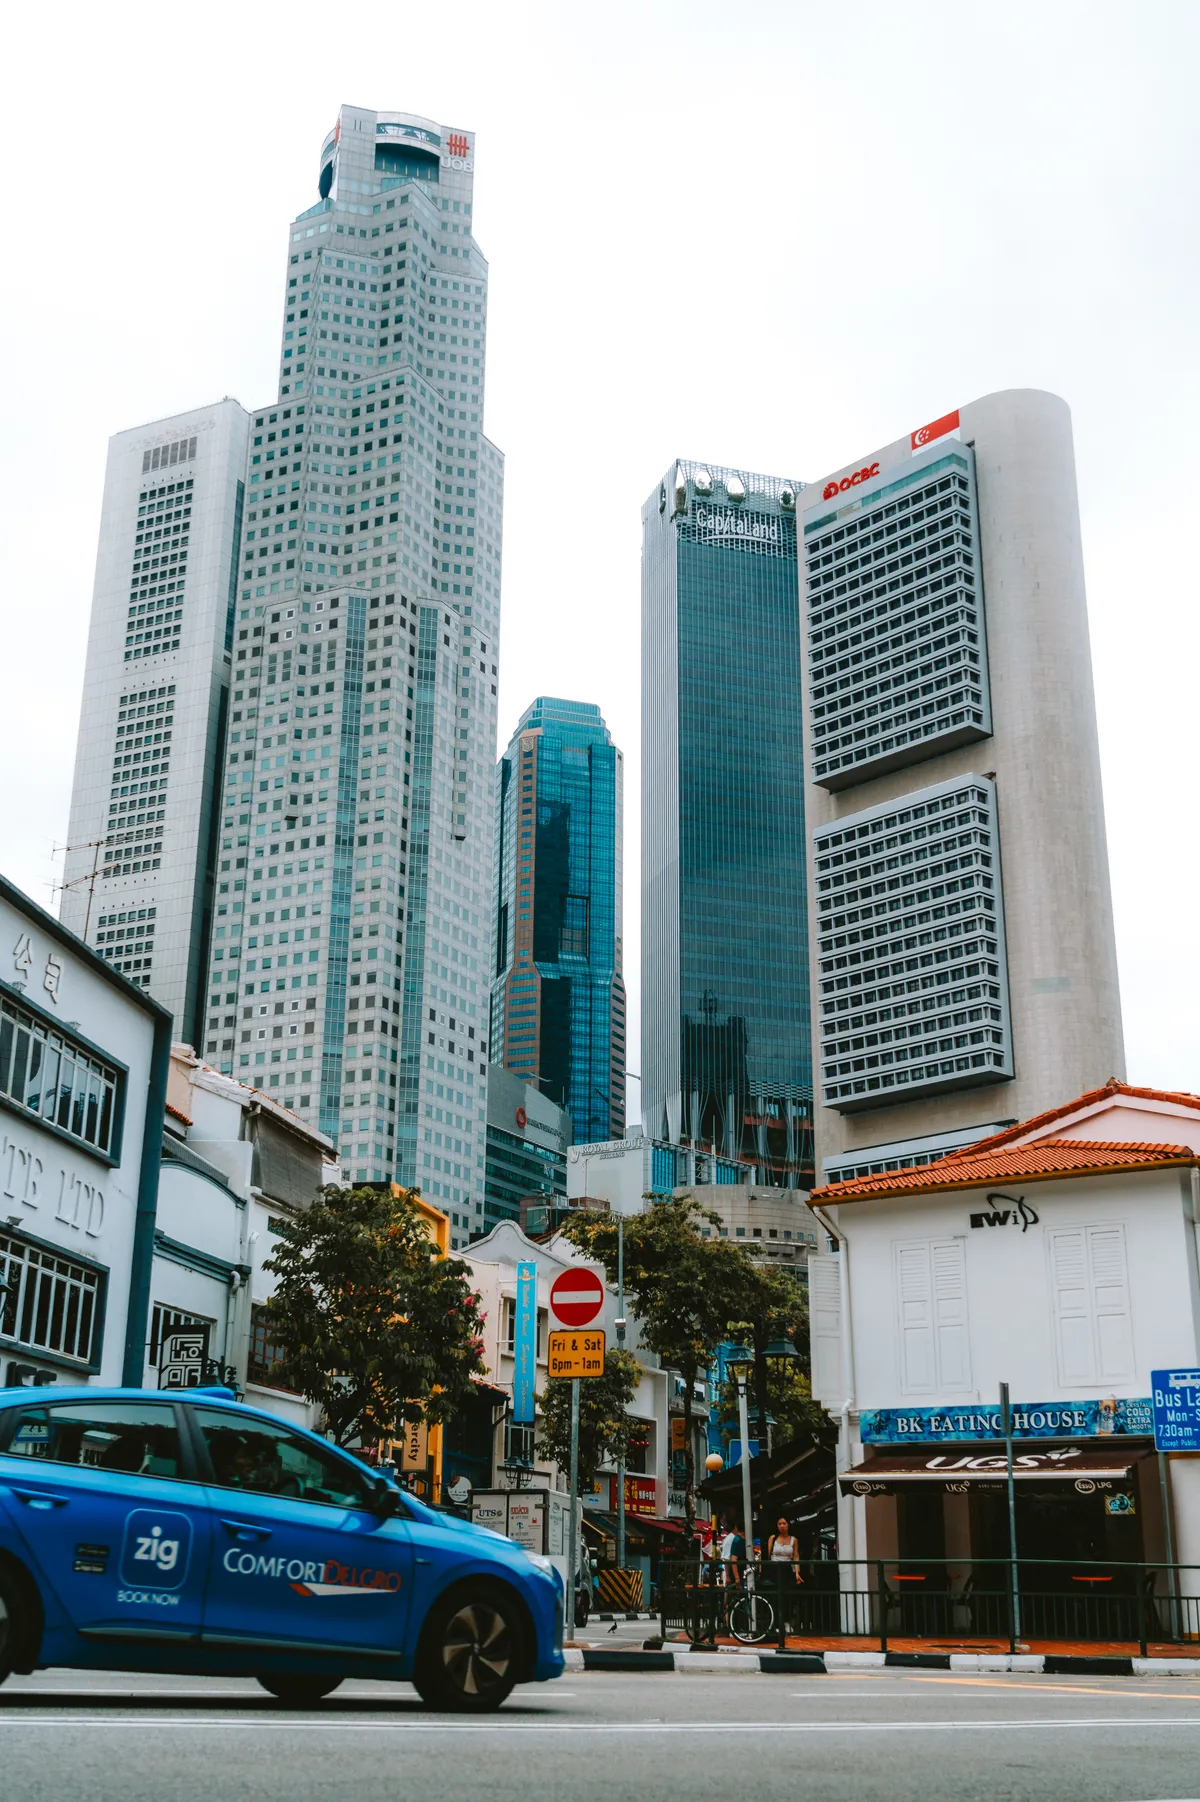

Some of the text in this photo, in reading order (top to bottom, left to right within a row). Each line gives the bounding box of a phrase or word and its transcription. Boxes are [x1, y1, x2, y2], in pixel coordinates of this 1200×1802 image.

[440, 156, 474, 173] UOB
[839, 462, 880, 492] OCBC
[696, 508, 778, 540] CapitaLand
[581, 1137, 643, 1156] ROYAL GROUP
[55, 1169, 104, 1239] LTD
[552, 1338, 602, 1351] Fri & Sat
[1155, 1389, 1182, 1408] Bus
[1126, 1407, 1151, 1417] COLD
[896, 1417, 923, 1433] BK
[1013, 1410, 1087, 1430] HOUSE
[1127, 1417, 1152, 1425] EXTRA
[925, 1455, 1048, 1469] UGS
[872, 1483, 887, 1491] LPG
[946, 1482, 969, 1493] UGS
[1097, 1481, 1113, 1489] LPG
[478, 1509, 497, 1517] UTS
[134, 1526, 179, 1570] zig
[117, 1590, 180, 1606] BOOK NOW
